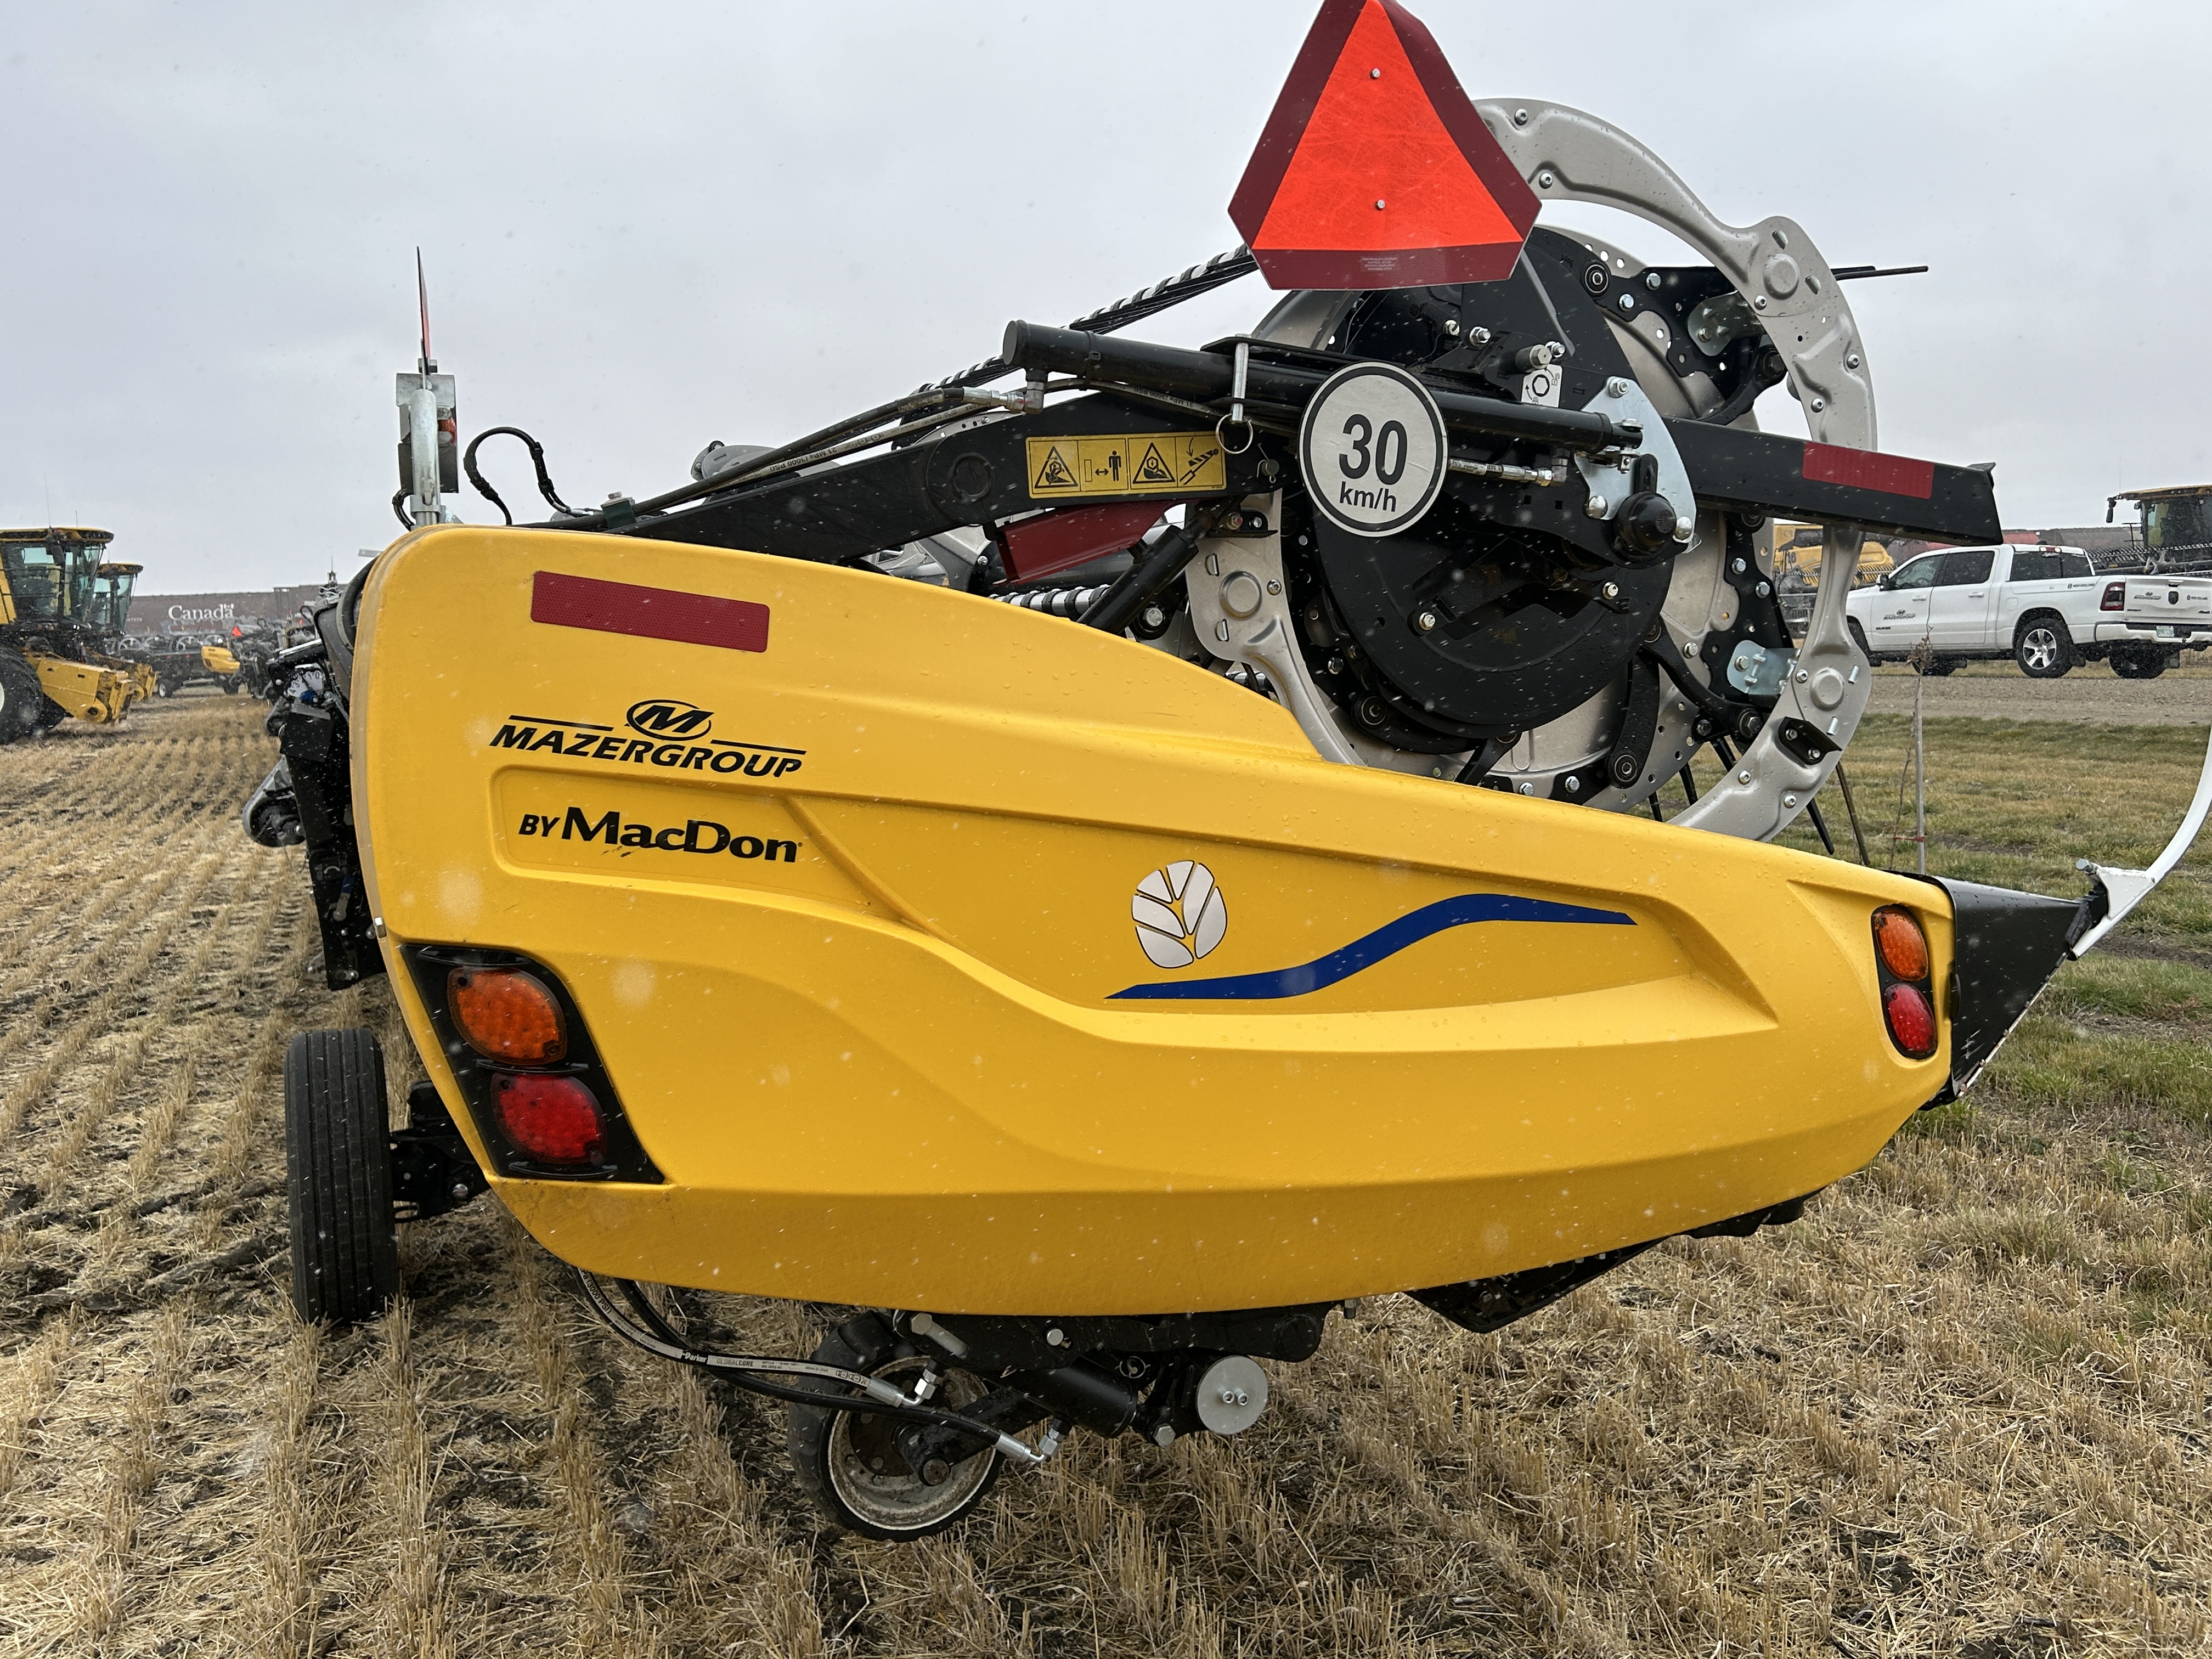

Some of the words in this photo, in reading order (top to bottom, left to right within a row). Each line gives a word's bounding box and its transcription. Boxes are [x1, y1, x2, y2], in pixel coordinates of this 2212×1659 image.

[787, 455, 808, 466] (3000
[1339, 414, 1407, 486] 30
[1339, 481, 1397, 512] km/h
[168, 603, 234, 621] Canada
[489, 725, 803, 778] MAZERGROUP
[518, 814, 560, 837] BY
[561, 806, 799, 863] MacDon
[586, 1279, 601, 1300] (3000
[598, 1298, 612, 1314] PSI)
[684, 1351, 708, 1363] Parker
